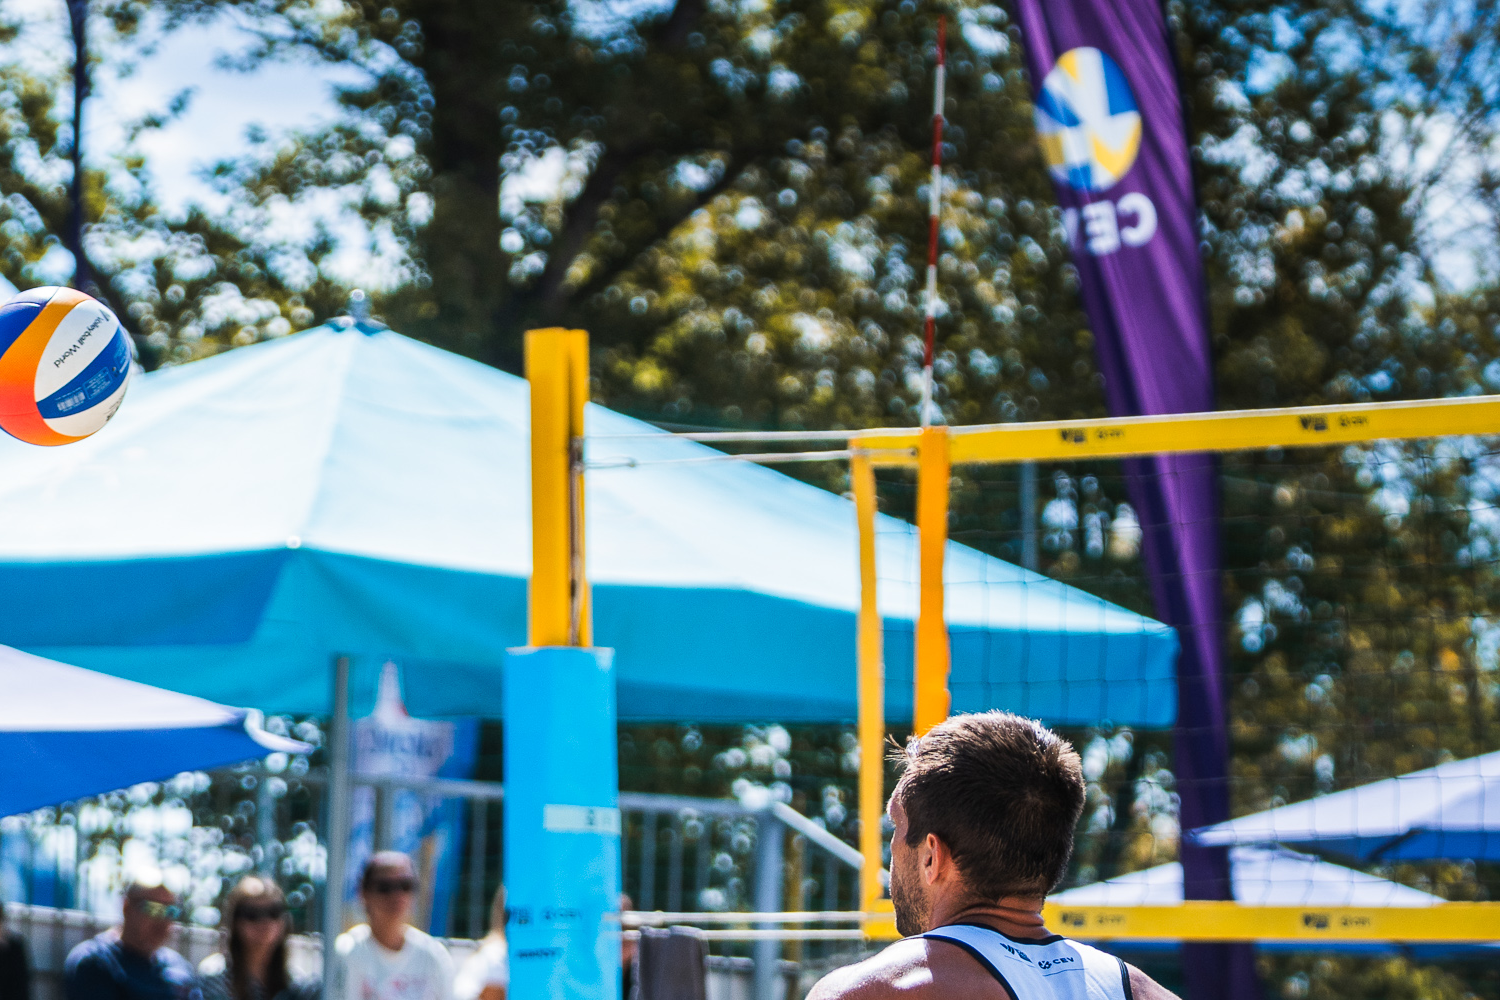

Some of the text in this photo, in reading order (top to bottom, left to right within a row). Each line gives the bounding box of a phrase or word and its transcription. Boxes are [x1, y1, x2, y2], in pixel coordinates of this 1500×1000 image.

[77, 316, 104, 346] Volleyball
[53, 344, 81, 368] World
[1052, 957, 1075, 965] CEV
